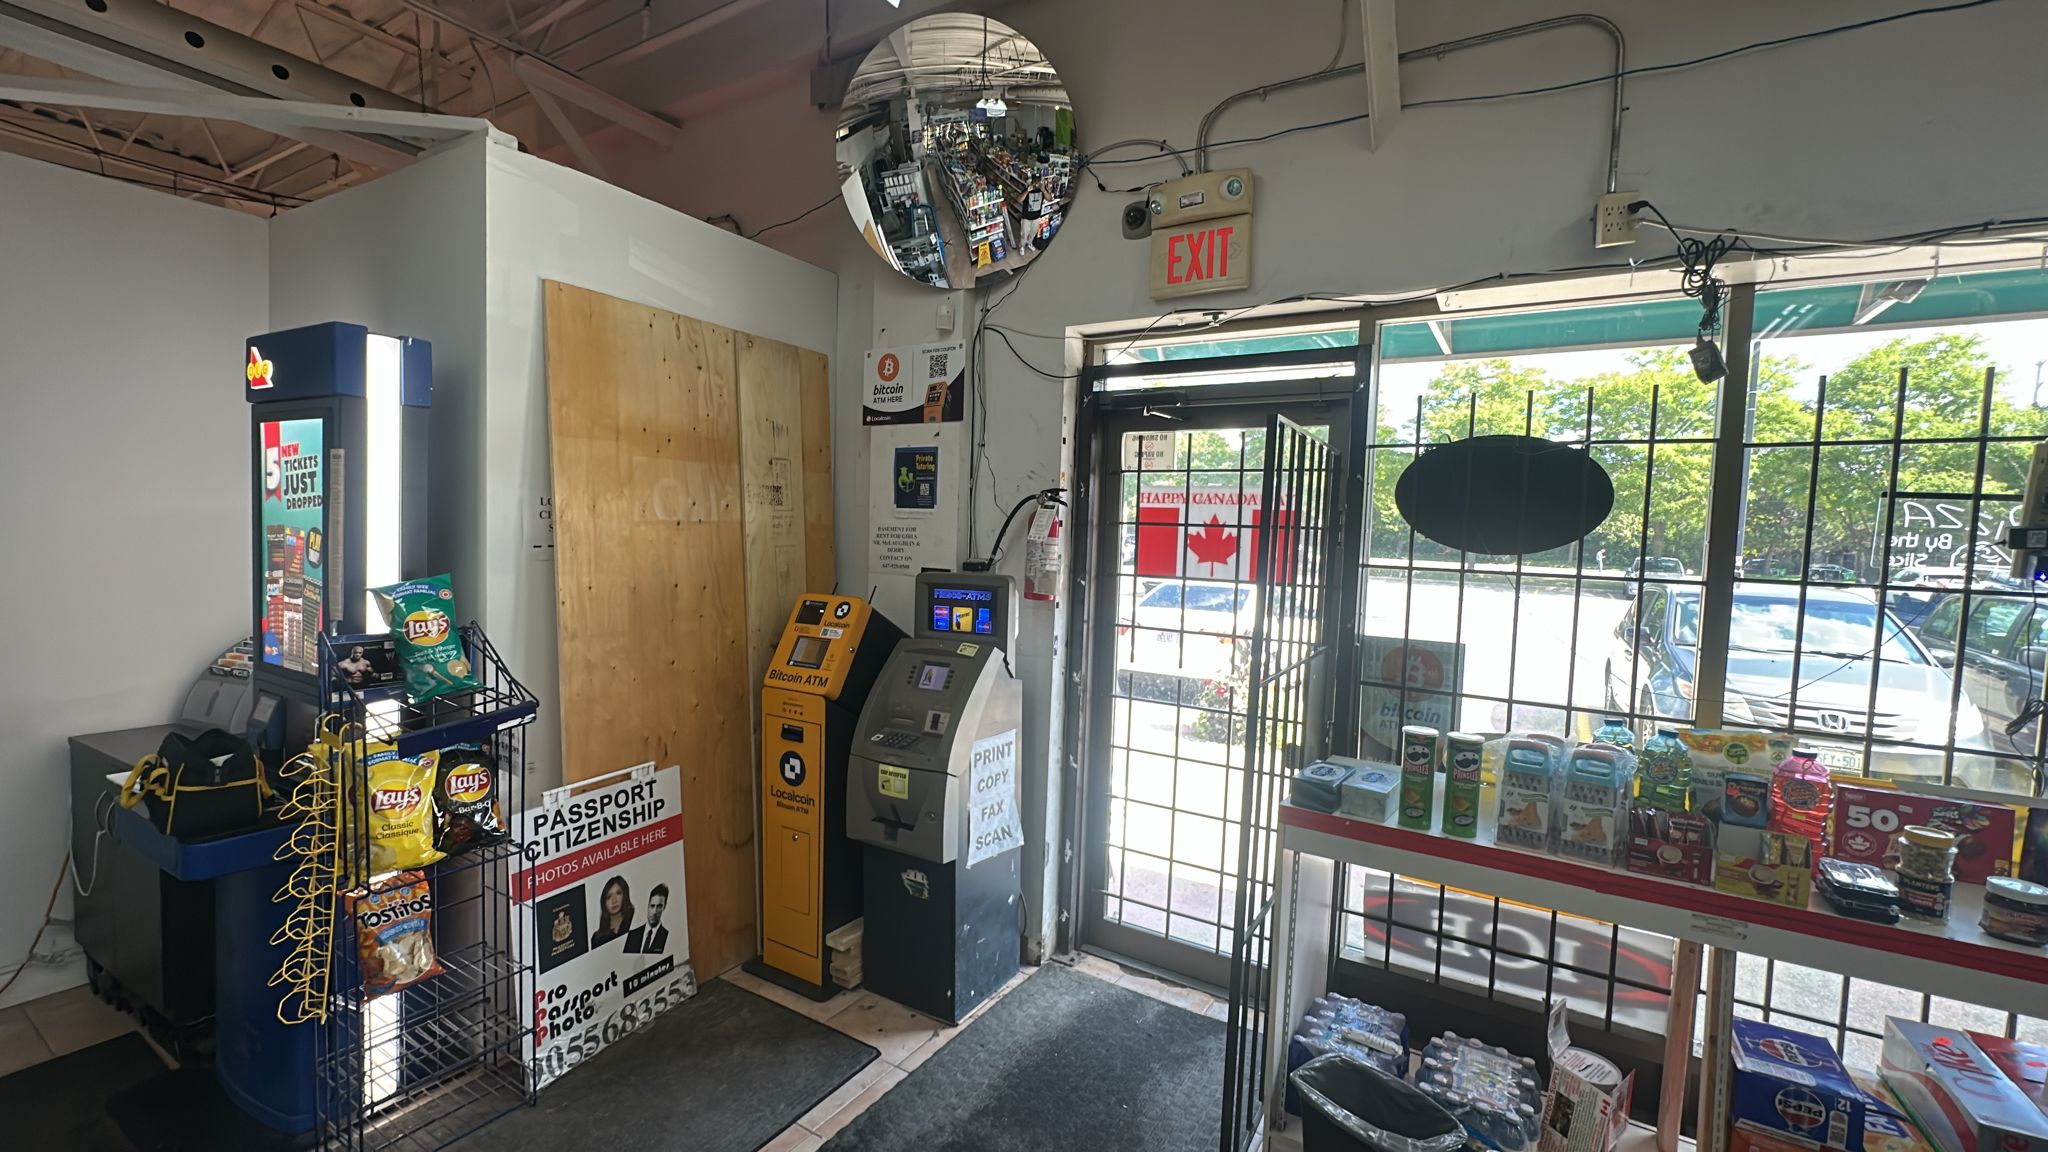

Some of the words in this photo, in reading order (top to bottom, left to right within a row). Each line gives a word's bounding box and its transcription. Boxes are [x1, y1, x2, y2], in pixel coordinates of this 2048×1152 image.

[1167, 226, 1234, 284] EXIT
[873, 383, 904, 396] bitcoin
[873, 396, 887, 404] ATM
[281, 443, 300, 458] NEW
[916, 454, 934, 462] Private
[266, 447, 280, 491] 5
[284, 455, 318, 472] TICKETS
[916, 462, 935, 472] Tutoring
[284, 470, 317, 496] JUST
[286, 494, 323, 510] DROPPED
[1140, 492, 1186, 505] HAPPY
[407, 616, 448, 640] Lay's
[769, 668, 802, 684] Bitcoin
[804, 676, 828, 688] ATM
[1380, 701, 1440, 724] bicoin
[974, 741, 1013, 769] PRINT
[451, 770, 488, 795] Lay's
[977, 768, 1009, 793] COPY
[375, 788, 421, 812] Lay's
[770, 785, 815, 807] Localcoin
[533, 780, 656, 836] PASSPORT
[776, 801, 796, 812] Bitcoin
[796, 804, 809, 814] ATM
[980, 800, 1004, 822] FAX
[1846, 804, 1899, 832] 50
[376, 828, 420, 840] Classique
[381, 820, 414, 832] Classic
[524, 798, 665, 862] CITIZENSHIP
[976, 824, 1013, 851] SCAN
[527, 860, 579, 890] PHOTOS
[581, 838, 639, 868] AVAILABLE
[641, 826, 668, 846] HERE
[628, 980, 639, 990] 10
[640, 962, 670, 985] minutes
[1777, 1097, 1823, 1118] PEPSI
[1838, 1098, 1852, 1113] 12
